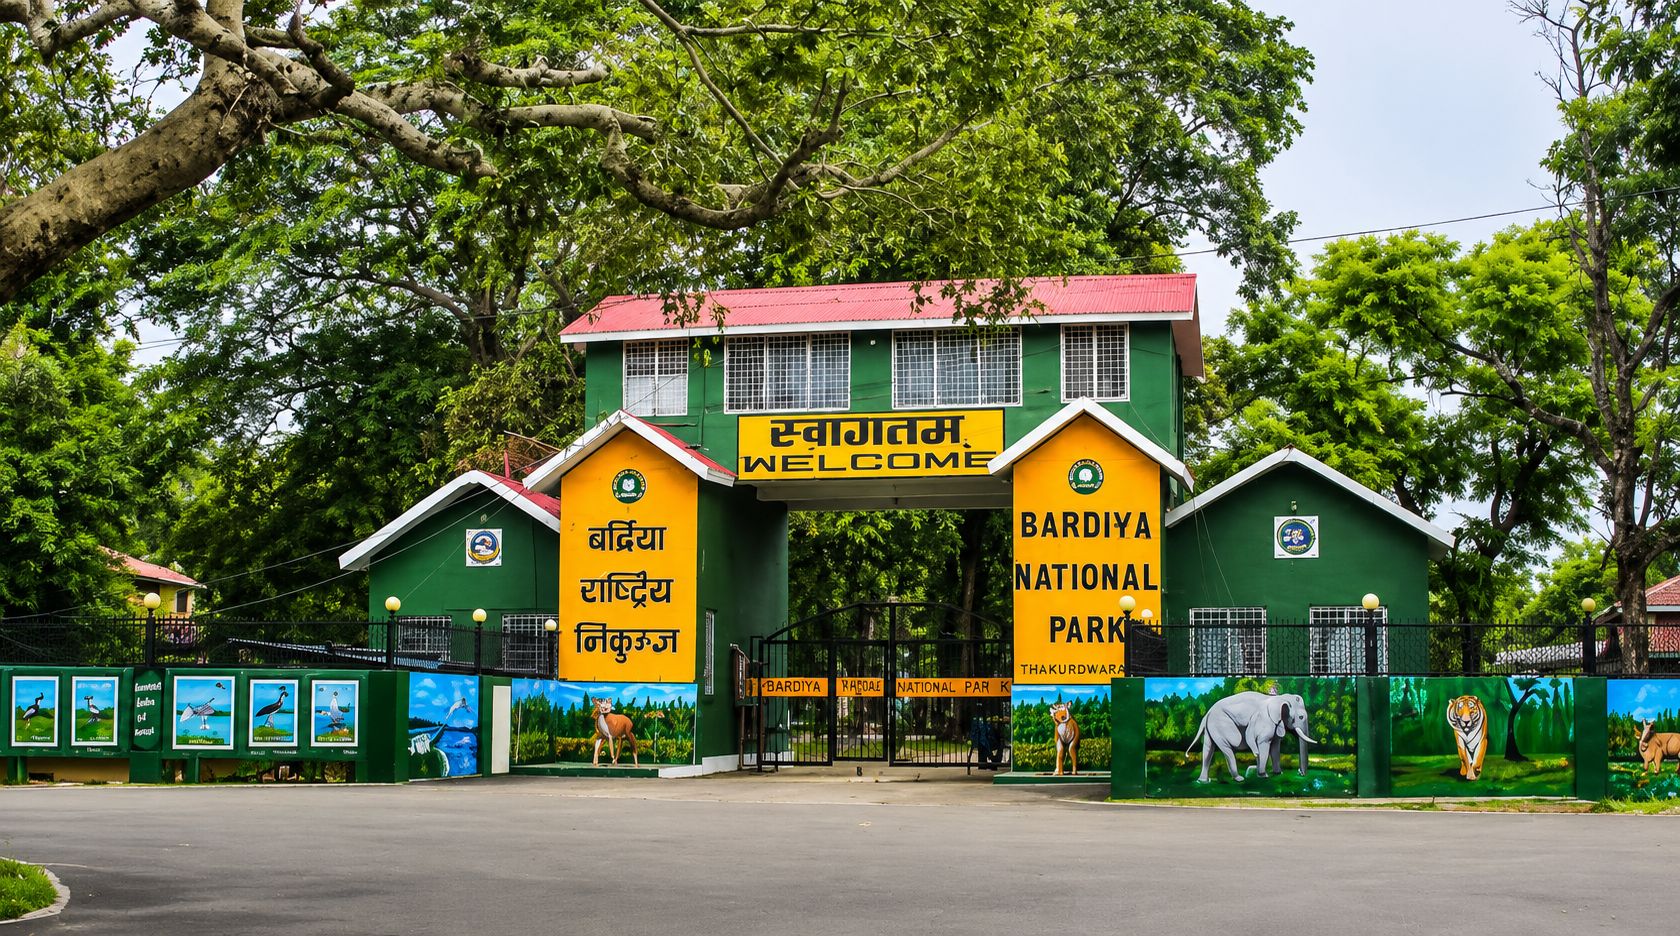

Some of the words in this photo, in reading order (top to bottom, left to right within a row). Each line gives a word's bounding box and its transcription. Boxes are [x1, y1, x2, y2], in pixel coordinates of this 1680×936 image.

[741, 451, 997, 473] WELCOME
[1021, 511, 1151, 539] BARDIYA
[1015, 563, 1158, 591] NATIONAL
[1050, 616, 1125, 643] PARK
[1021, 664, 1125, 675] THAKURDWARA
[766, 680, 821, 693] BARDIYA
[898, 681, 956, 694] NATIONAL
